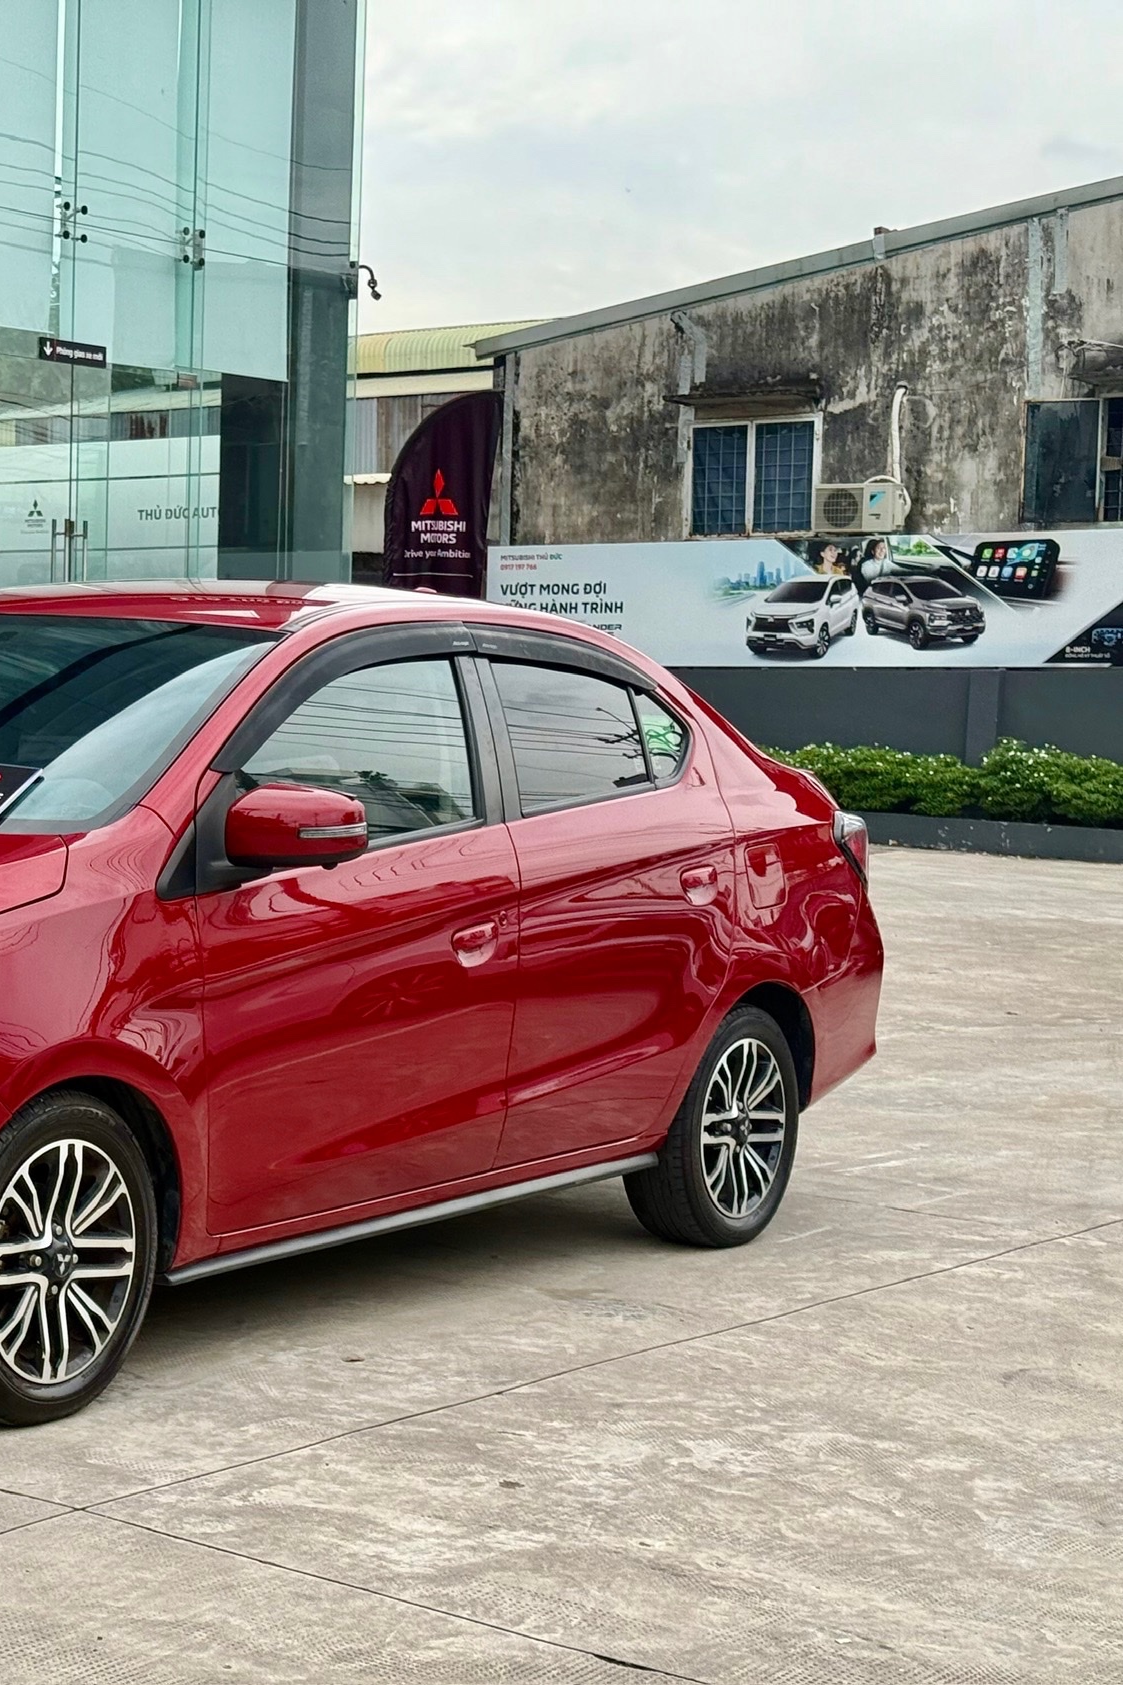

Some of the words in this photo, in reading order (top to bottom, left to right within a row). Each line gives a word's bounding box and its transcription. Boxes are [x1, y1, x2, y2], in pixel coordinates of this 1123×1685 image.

[137, 505, 162, 520] THỦ
[165, 505, 190, 520] ĐỨC
[410, 520, 466, 532] MITSUBISHI
[536, 552, 548, 560] THỦ
[549, 552, 563, 560] ĐỨC
[500, 582, 536, 598] VƯỢT
[539, 583, 580, 595] MONG
[583, 580, 607, 598] ĐỢI
[540, 599, 578, 614] HÀNH
[581, 598, 624, 614] TRÌNH
